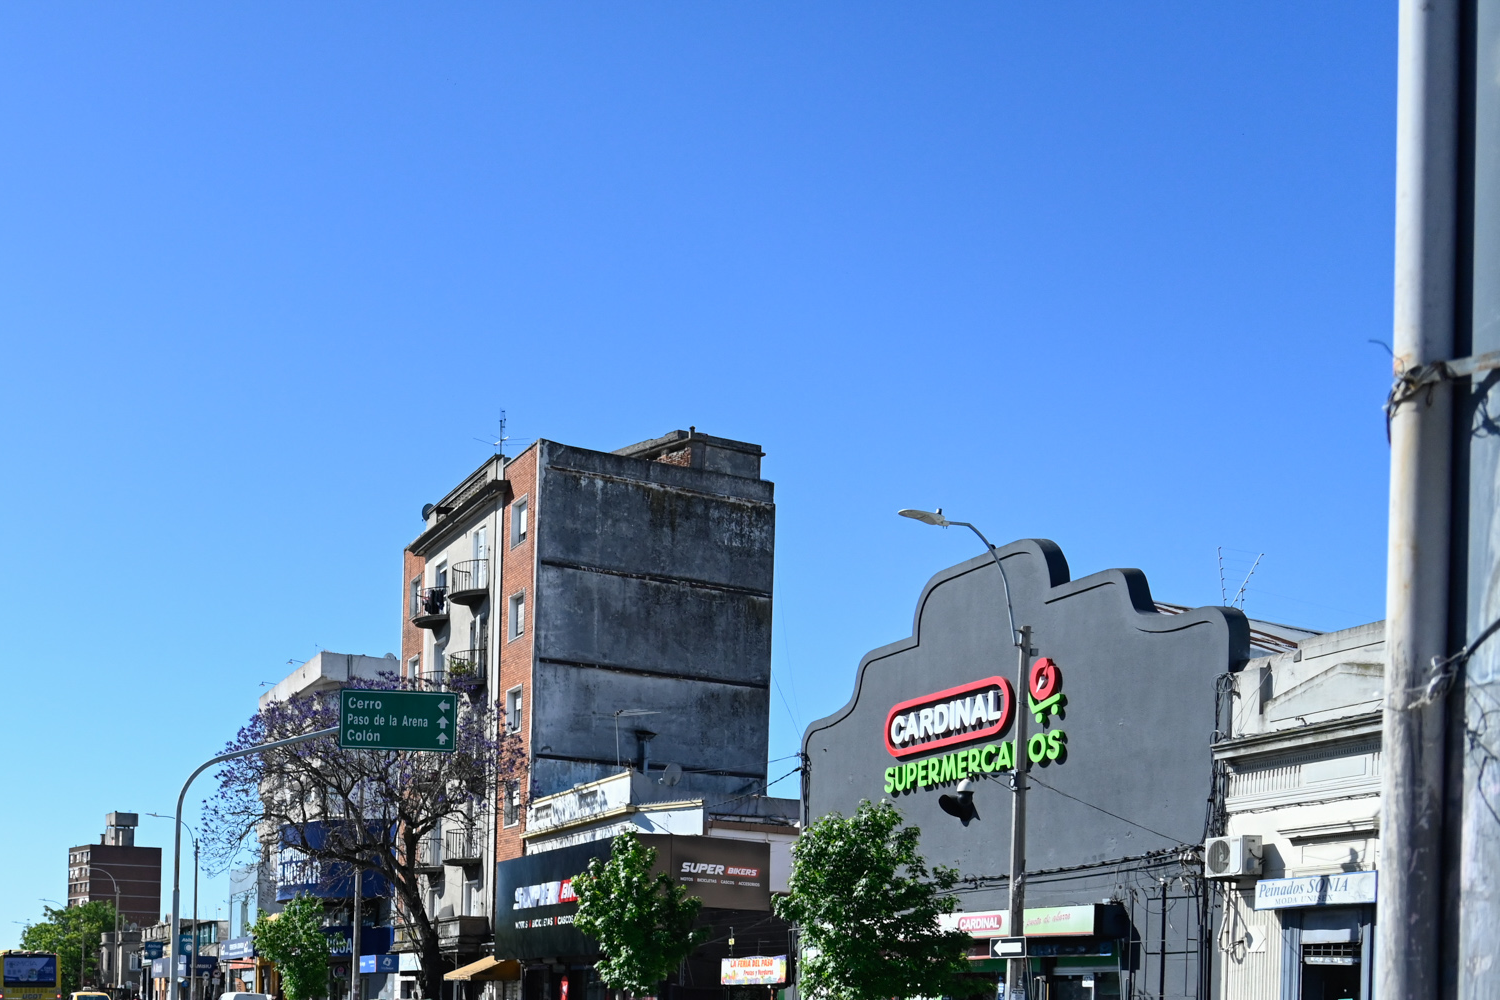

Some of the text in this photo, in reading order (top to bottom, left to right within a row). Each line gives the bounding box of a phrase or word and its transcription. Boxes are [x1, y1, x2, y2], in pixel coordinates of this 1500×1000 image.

[348, 697, 382, 710] Cerro
[347, 713, 428, 728] Paso de la Arena
[890, 690, 1002, 745] CARDINAL
[347, 729, 380, 742] Colón
[884, 729, 1065, 793] SUPERMERCAOS
[680, 861, 758, 877] SUPER BIKERS
[1258, 877, 1349, 898] Peinados SONIA
[512, 881, 561, 910] SUPER
[1274, 894, 1334, 905] MODA UNISEX
[958, 916, 1000, 930] CARDINAL
[730, 958, 774, 968] LA FERIA DEL PASO
